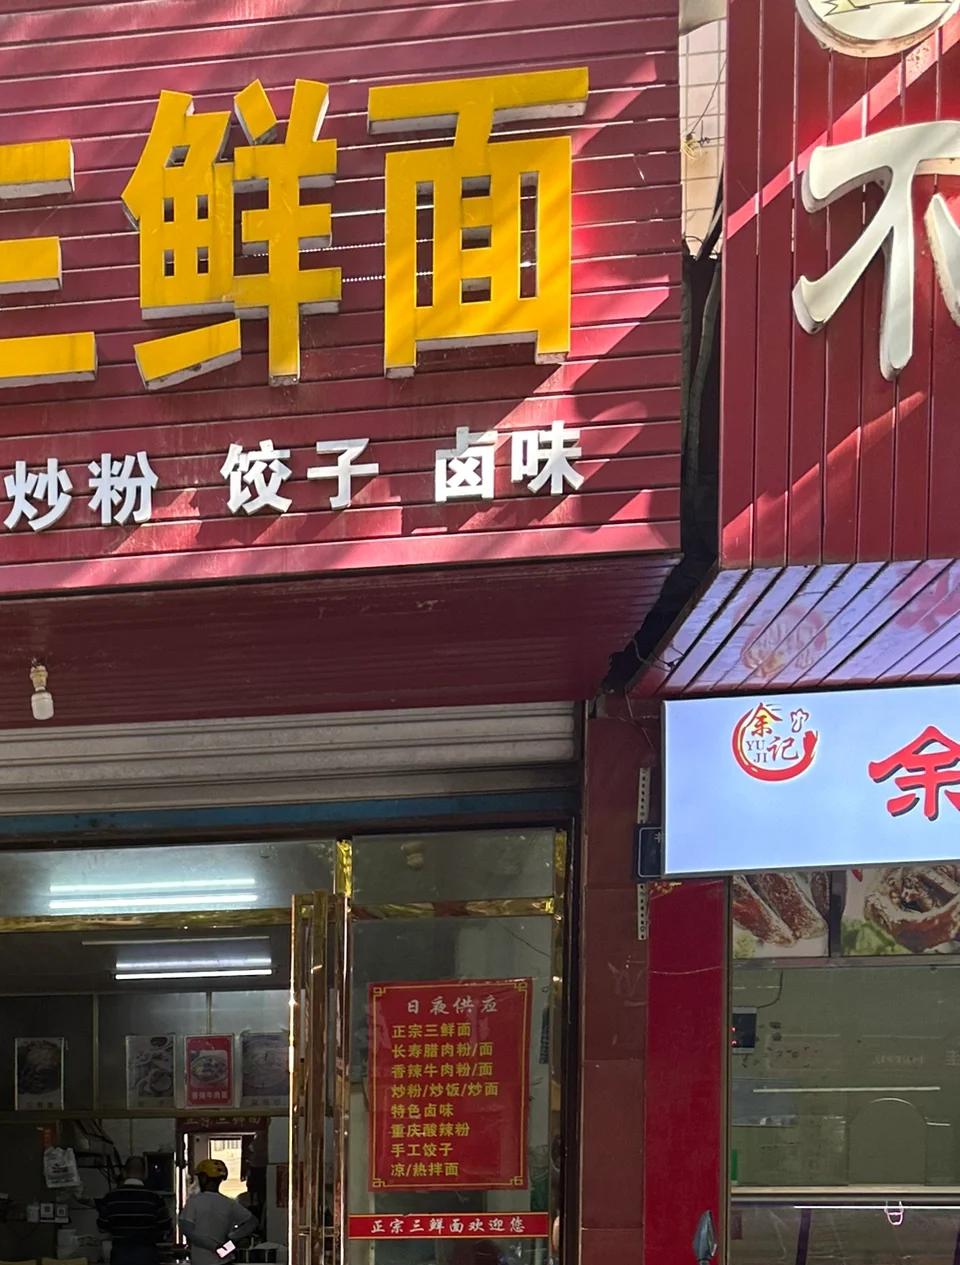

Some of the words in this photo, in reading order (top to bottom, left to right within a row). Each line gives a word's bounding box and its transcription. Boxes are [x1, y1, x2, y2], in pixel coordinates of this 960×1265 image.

[3, 451, 158, 531] 炒粉
[220, 439, 379, 515] 饺子
[434, 420, 585, 502] 卤味
[392, 1022, 472, 1039] 正宗三鲜面
[392, 1041, 493, 1059] 长寿腊肉粉/面
[391, 1062, 493, 1079] 香辣牛肉粉/面
[391, 1082, 499, 1098] 炒粉/炒饭/炒面
[391, 1103, 454, 1119] 特色卤味
[391, 1123, 470, 1139] 重庆酸辣粉
[391, 1143, 453, 1157] 手工饺子
[391, 1162, 459, 1178] 凉/热拌面
[371, 1217, 526, 1234] 正宗三鲜面欢迎您
